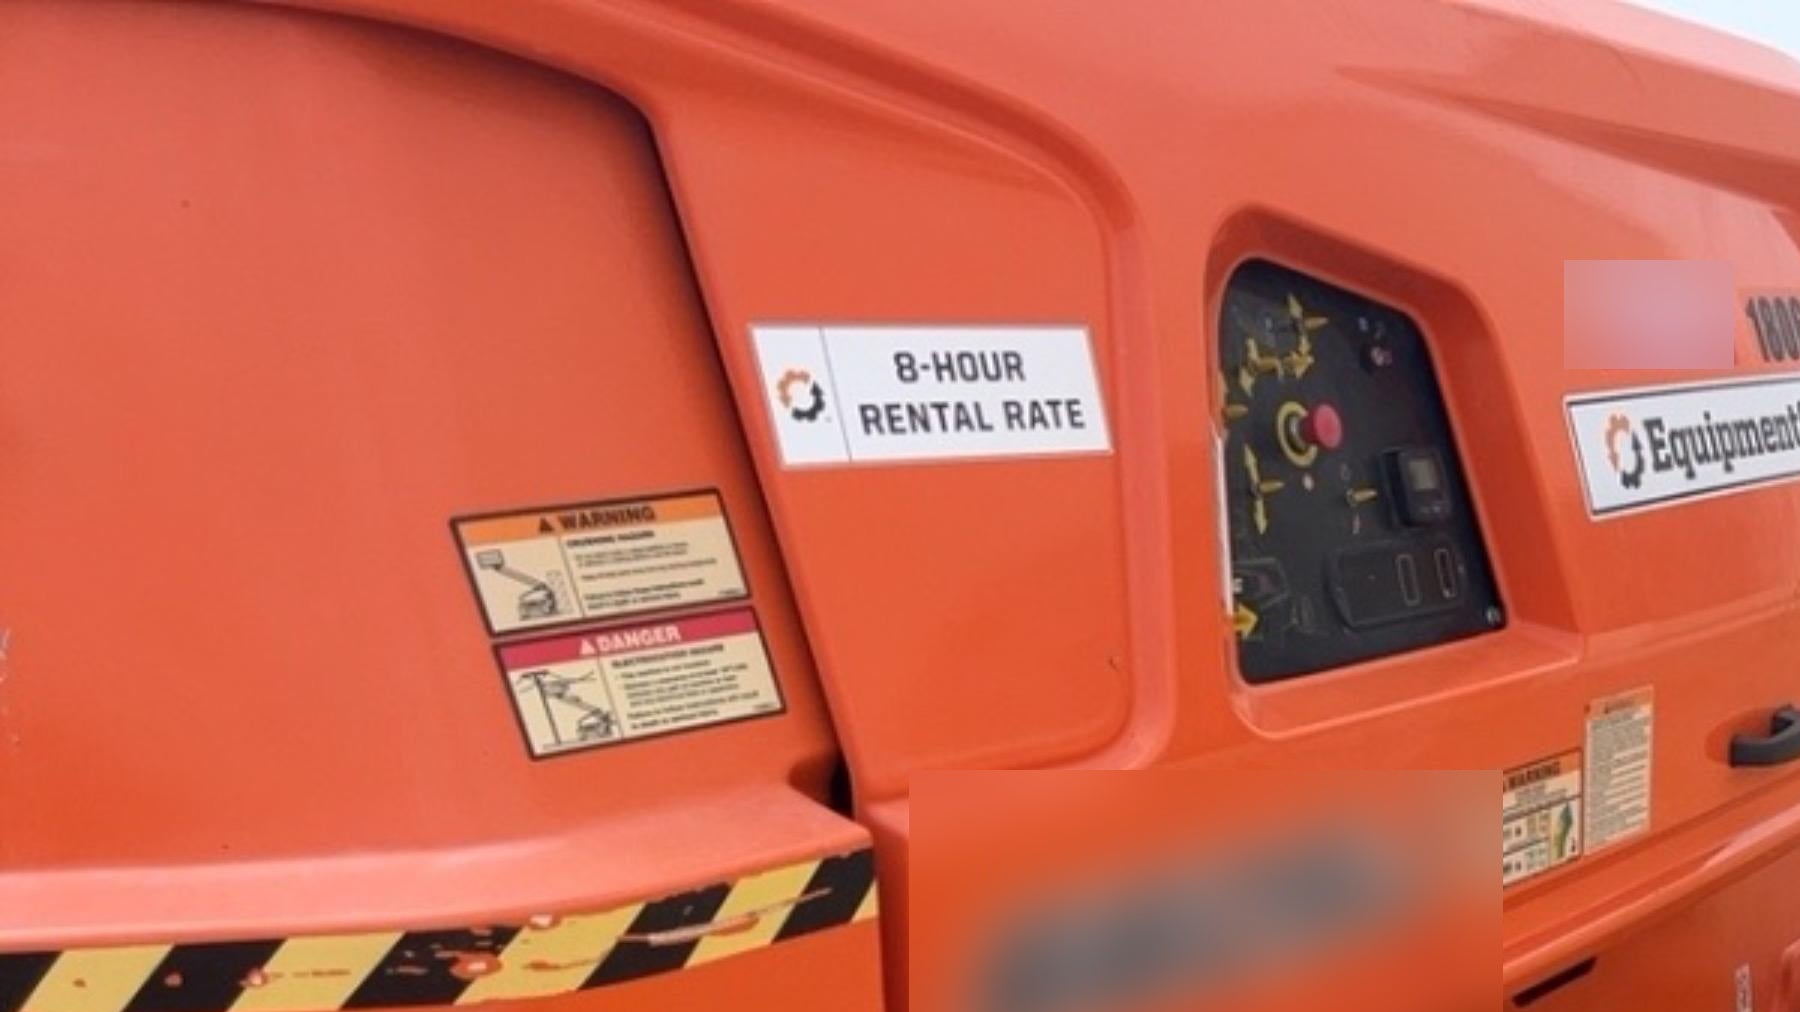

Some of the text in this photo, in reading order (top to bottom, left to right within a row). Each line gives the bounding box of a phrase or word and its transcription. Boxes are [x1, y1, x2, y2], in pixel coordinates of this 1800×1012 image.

[893, 350, 1027, 385] 8-HOUR
[857, 397, 1087, 436] RENTAL RATE
[559, 505, 657, 531] WARNING
[595, 624, 682, 652] DANGER
